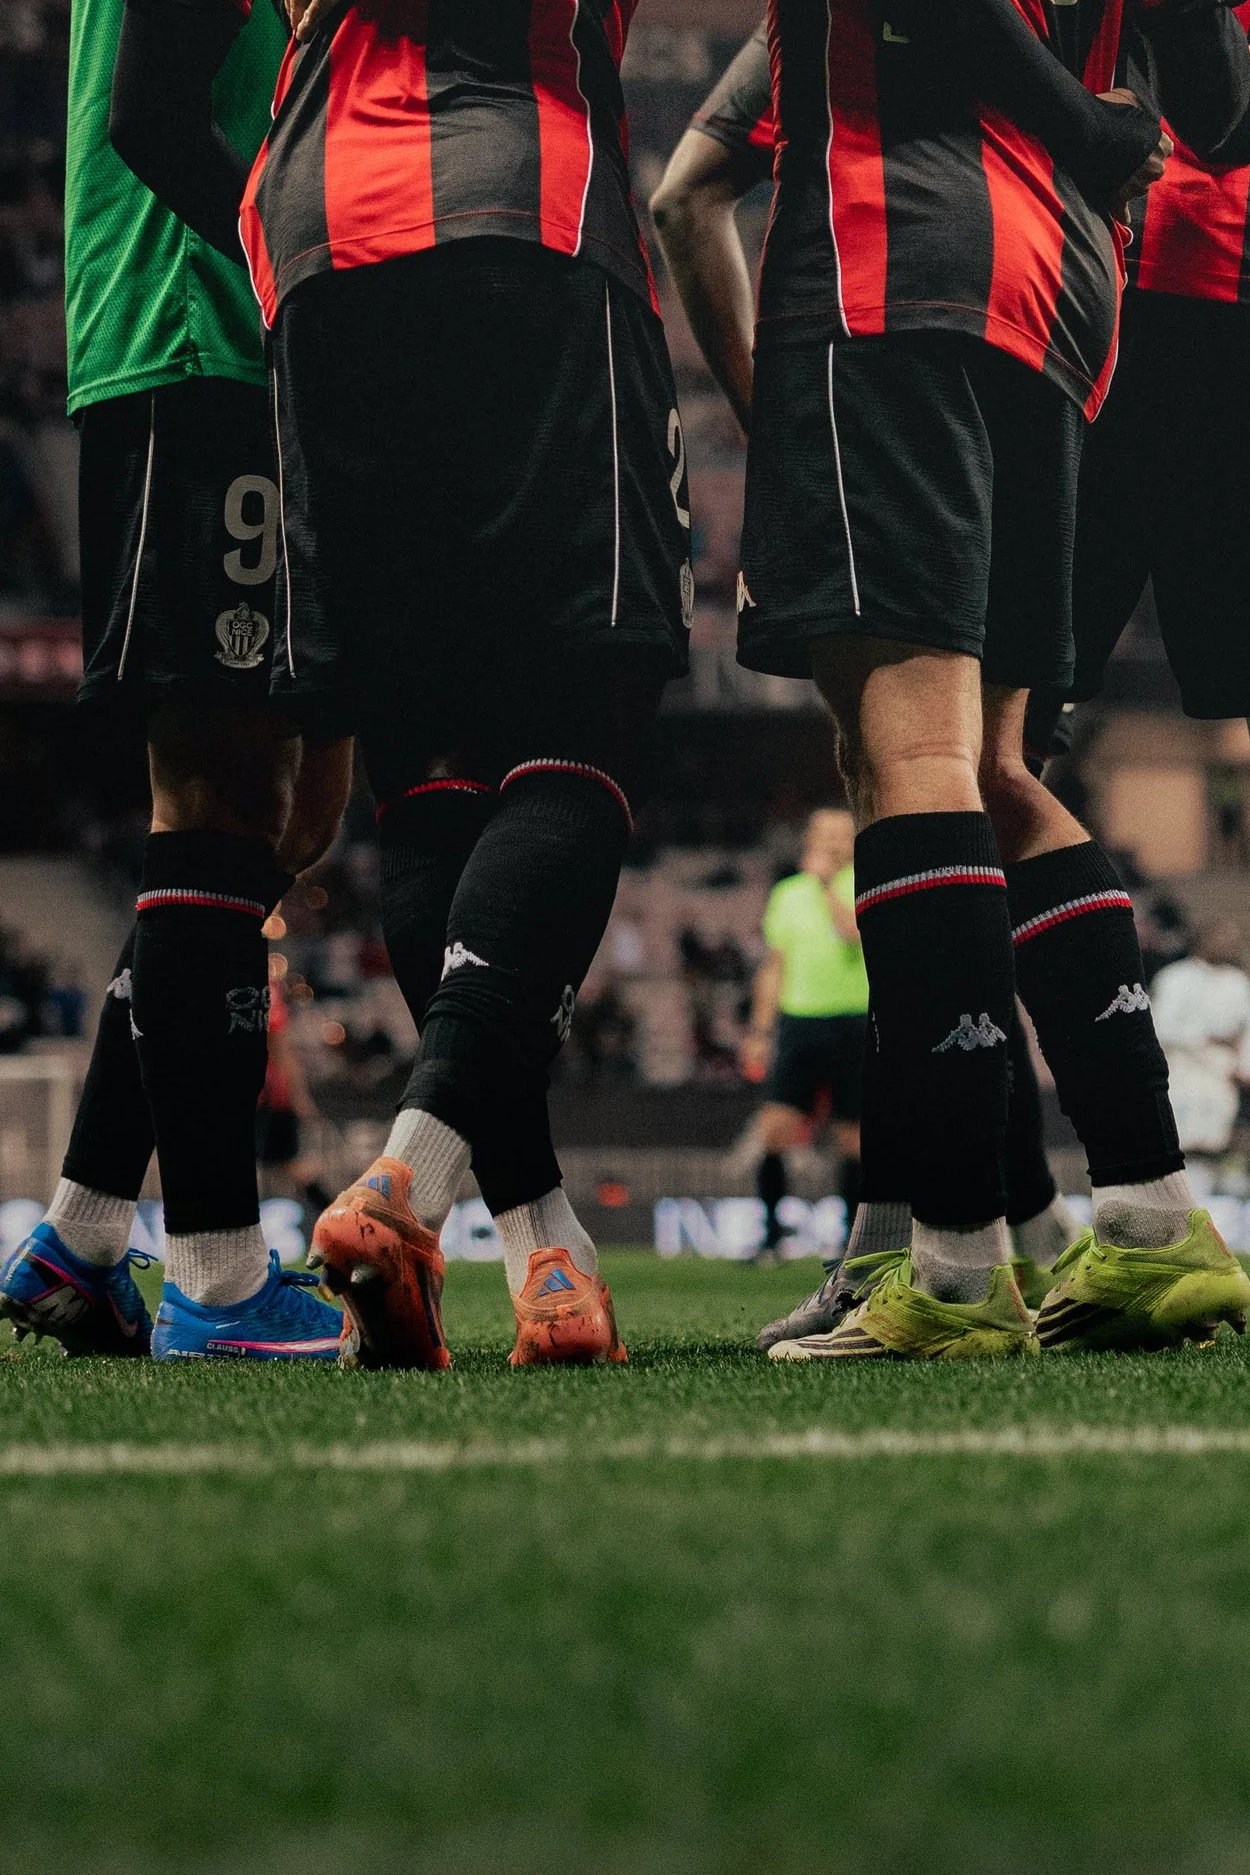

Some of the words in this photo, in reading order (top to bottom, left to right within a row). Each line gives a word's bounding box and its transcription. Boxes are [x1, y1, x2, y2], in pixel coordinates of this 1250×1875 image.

[223, 475, 281, 585] 9
[232, 621, 253, 629] OGC
[231, 628, 253, 637] NICE
[206, 1342, 239, 1354] CLAUSS
